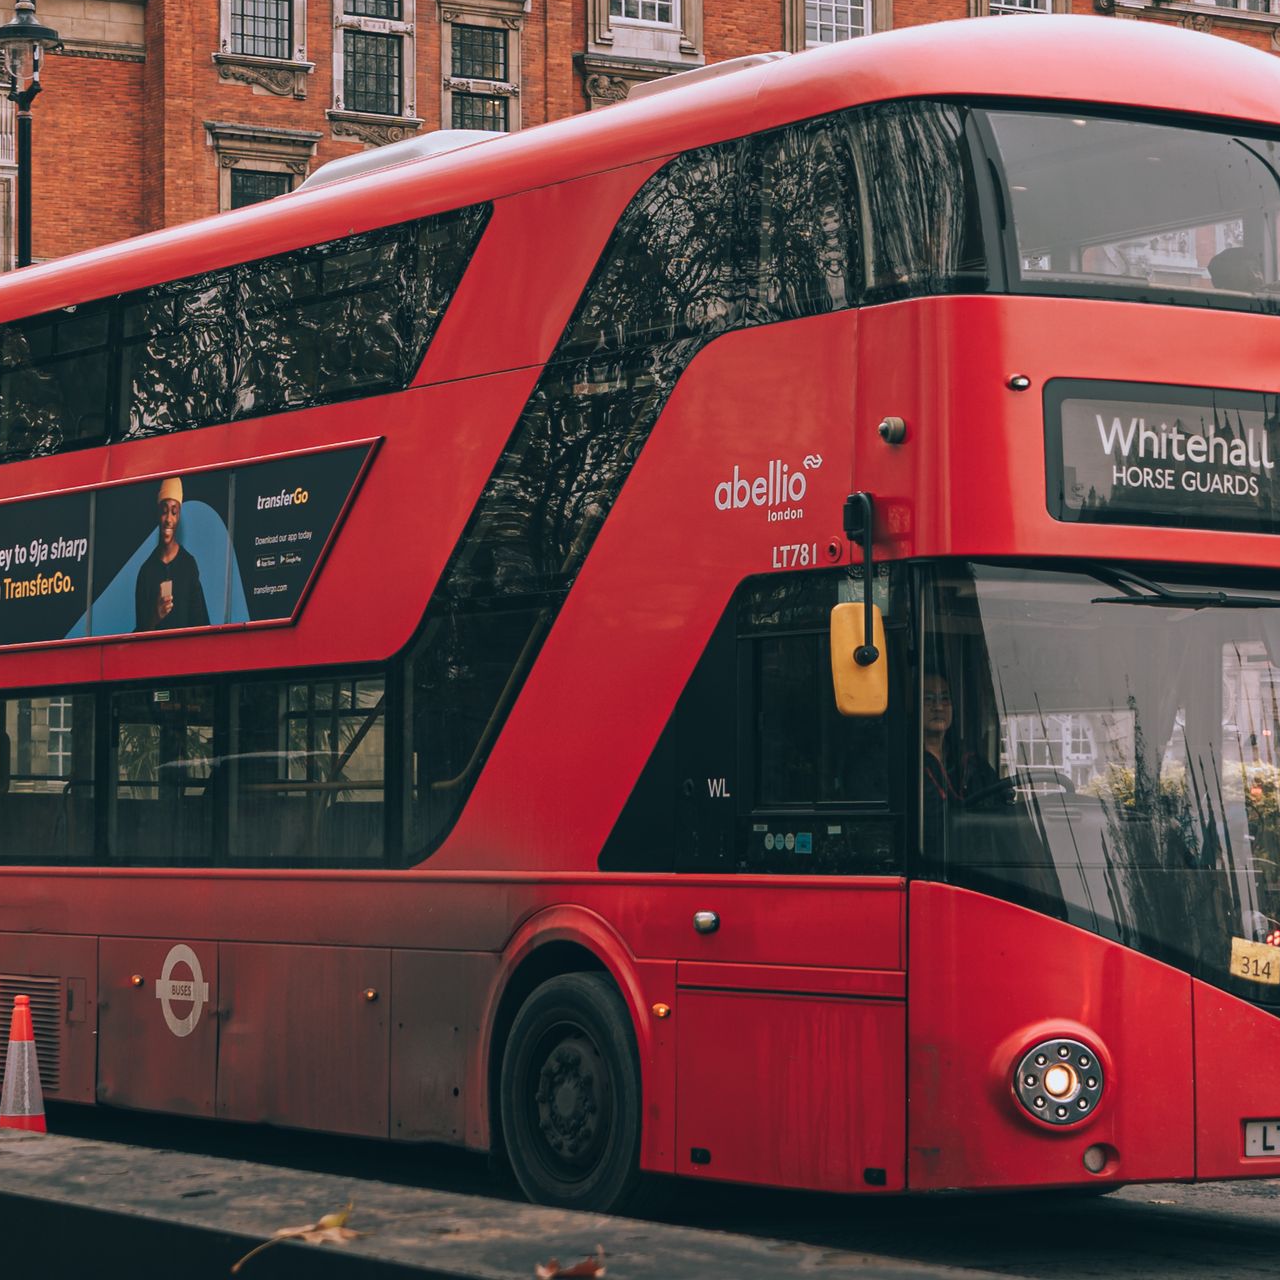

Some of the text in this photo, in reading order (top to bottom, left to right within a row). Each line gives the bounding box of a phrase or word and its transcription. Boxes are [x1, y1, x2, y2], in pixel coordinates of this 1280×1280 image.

[1096, 414, 1275, 469] Whitehall
[714, 459, 807, 511] abellio
[1112, 465, 1260, 497] HORSE GUARDS
[256, 487, 309, 510] transferGo
[767, 507, 803, 522] london
[255, 530, 313, 546] Download our app today
[14, 544, 27, 565] to
[29, 538, 49, 567] 9ja
[50, 536, 88, 562] sharp
[772, 542, 817, 569] LT781
[3, 571, 75, 601] TransferGo.
[253, 584, 288, 595] transfergo.com
[707, 778, 731, 798] WL
[1241, 956, 1271, 980] 314
[171, 984, 192, 997] BUSES
